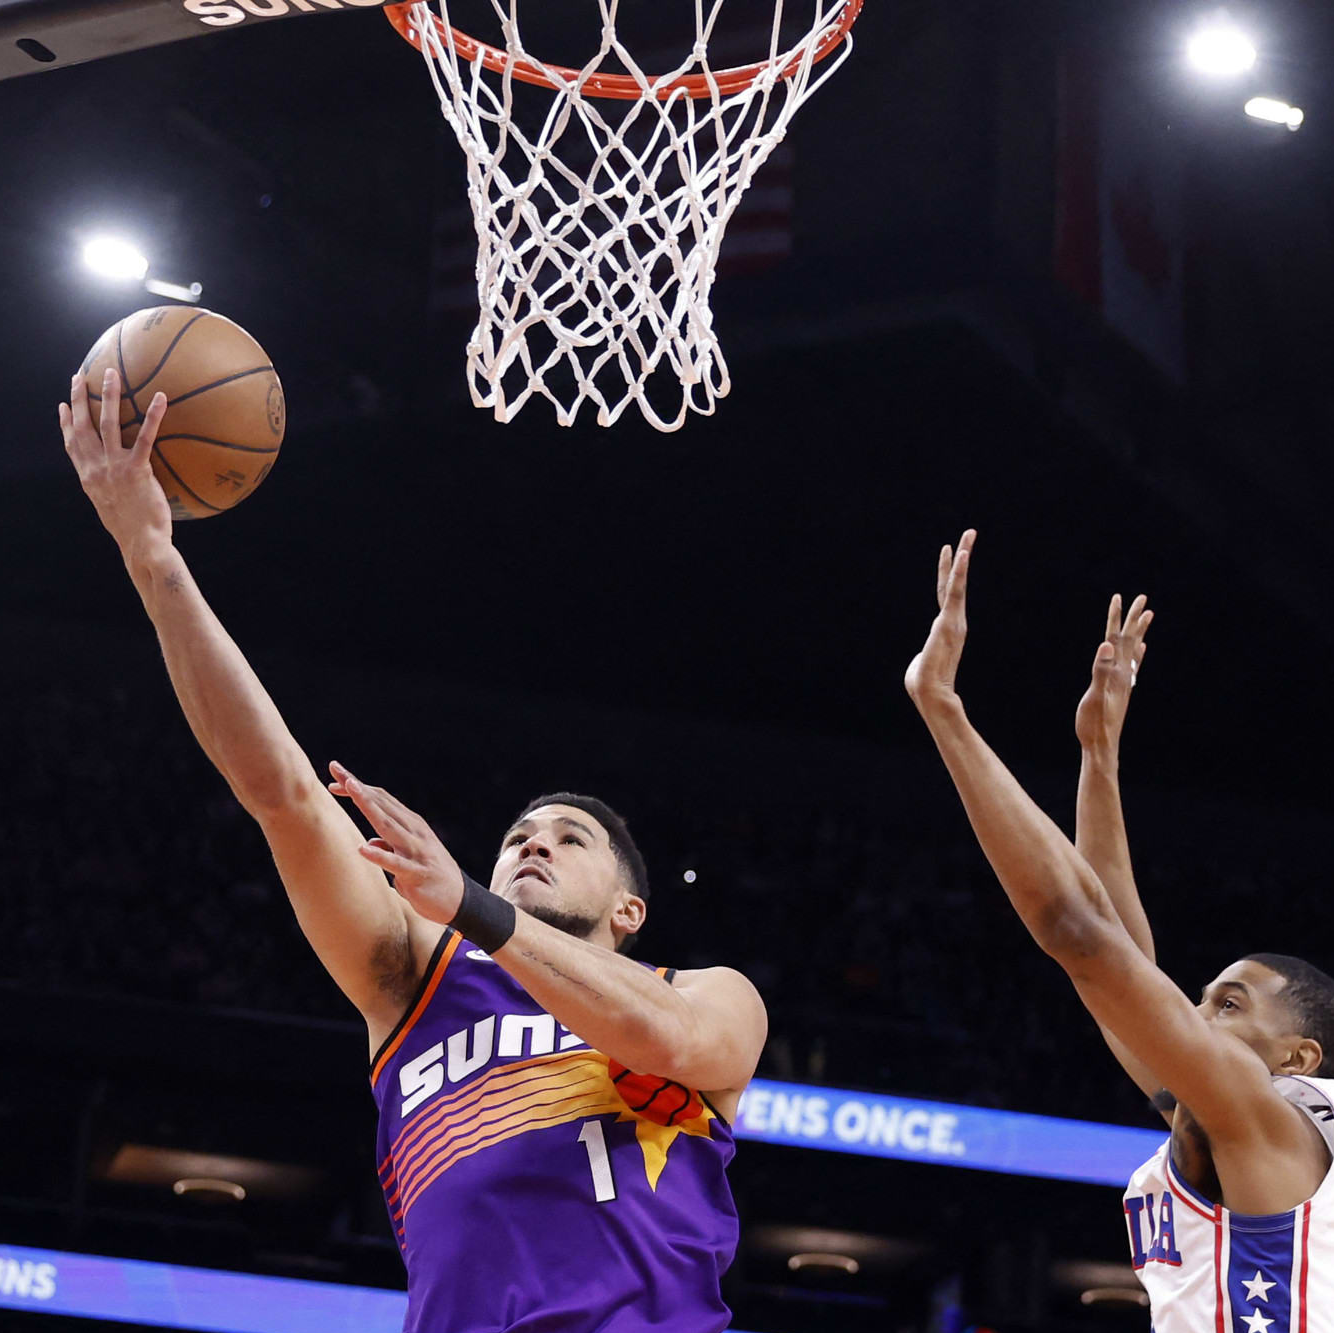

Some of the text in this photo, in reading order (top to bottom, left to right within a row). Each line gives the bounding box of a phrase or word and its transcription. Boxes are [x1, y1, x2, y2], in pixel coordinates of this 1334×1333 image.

[738, 1087, 965, 1156] ENS ONCE.
[577, 1119, 616, 1203] 1
